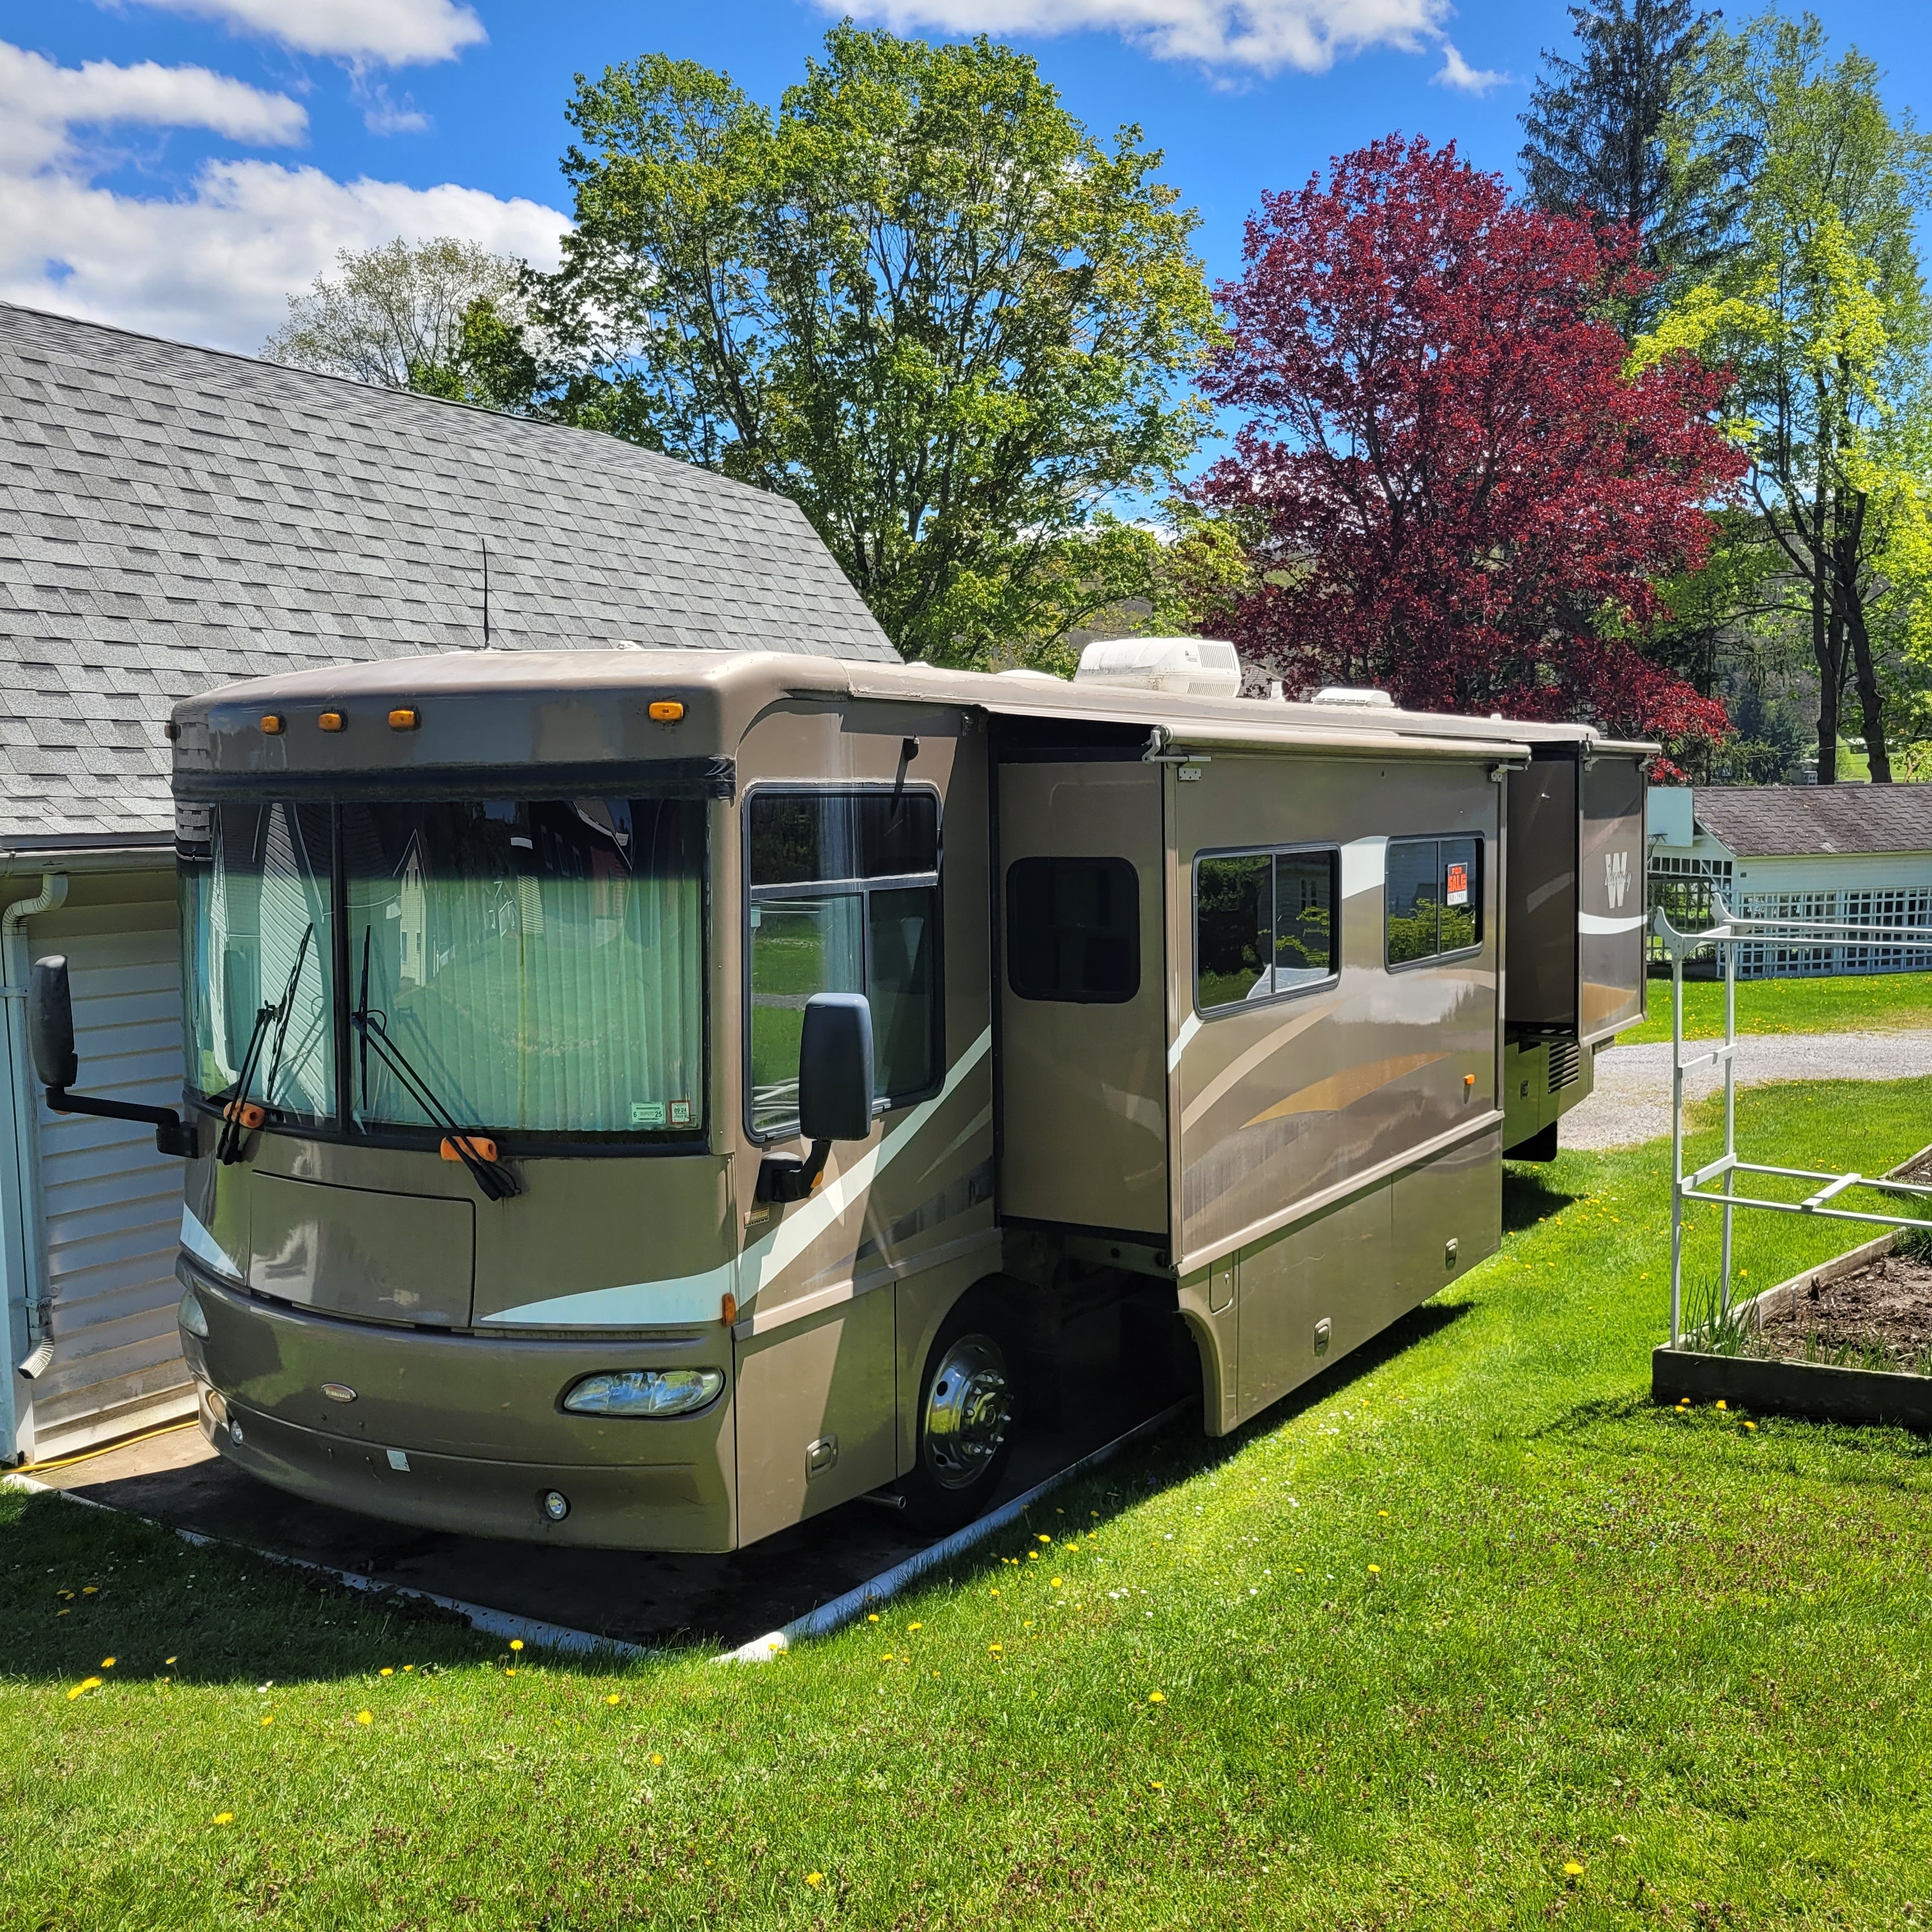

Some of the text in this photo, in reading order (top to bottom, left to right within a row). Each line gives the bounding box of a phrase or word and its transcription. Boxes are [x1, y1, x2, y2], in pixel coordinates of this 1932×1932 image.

[1452, 866, 1462, 875] FOR
[1448, 874, 1466, 892] SALE
[1605, 852, 1628, 909] W
